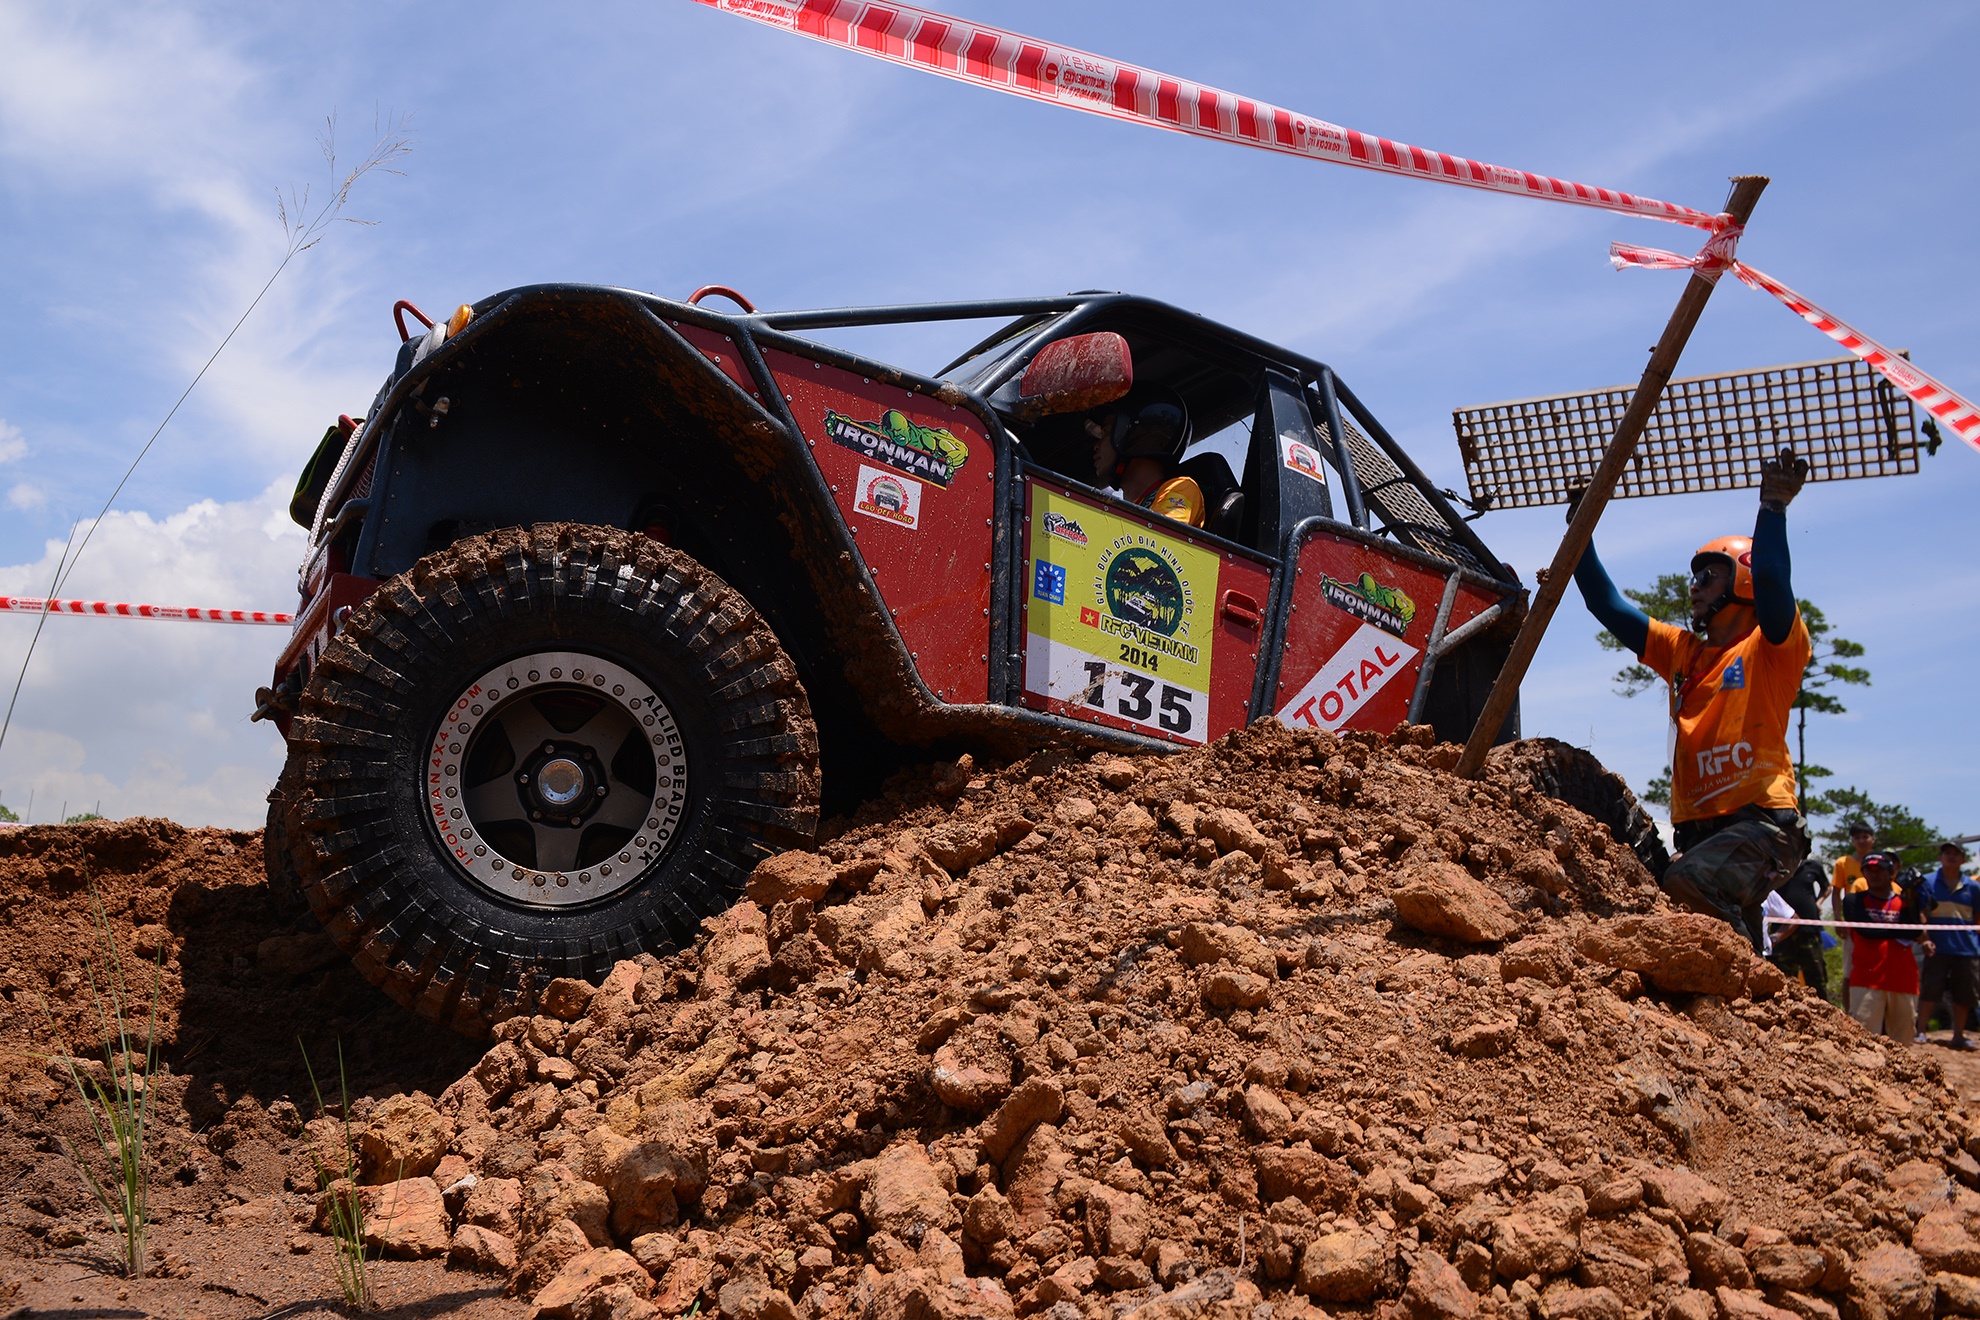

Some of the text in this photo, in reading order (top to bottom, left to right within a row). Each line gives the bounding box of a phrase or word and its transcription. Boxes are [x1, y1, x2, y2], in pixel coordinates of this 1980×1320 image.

[835, 422, 948, 478] IRONMAN
[864, 448, 874, 458] 4
[906, 465, 916, 474] 4
[860, 503, 913, 524] LAO OFF ROAD
[1055, 525, 1089, 544] OFFROAD
[1328, 585, 1403, 631] IRONMAN
[1119, 643, 1158, 672] 2014
[1083, 662, 1192, 734] 135
[1292, 645, 1401, 729] TOTAL
[643, 694, 683, 758] ALLIED
[430, 684, 482, 867] IRONMAN4X4.COM
[1696, 741, 1754, 779] RFC
[638, 764, 686, 867] BEADLOCK
